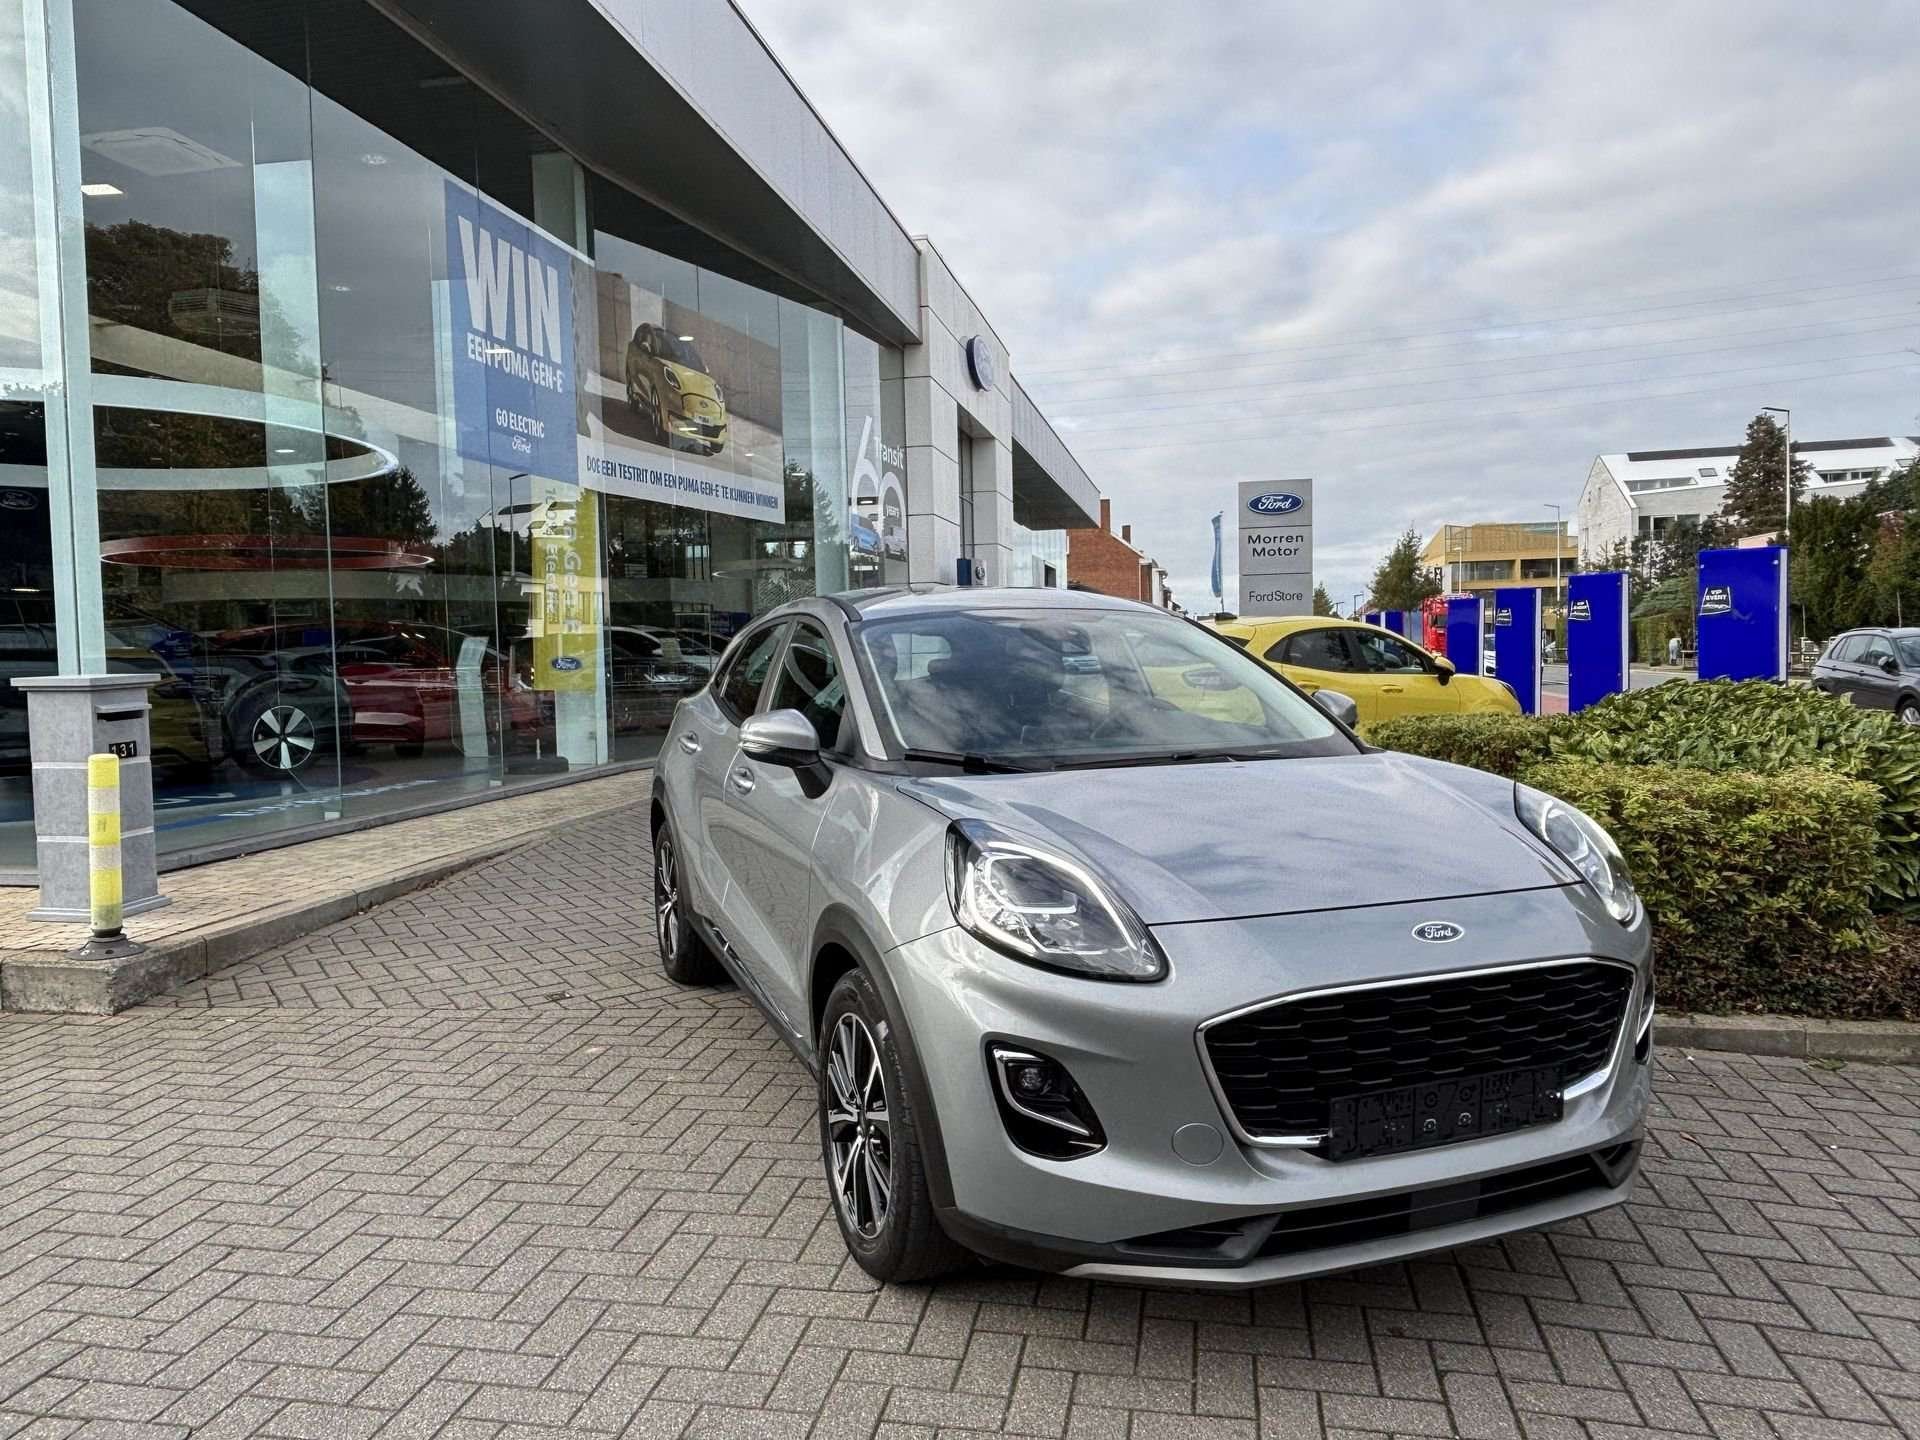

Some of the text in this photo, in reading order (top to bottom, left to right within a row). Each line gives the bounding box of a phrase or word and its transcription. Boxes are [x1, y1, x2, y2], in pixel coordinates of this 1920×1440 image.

[458, 215, 562, 364] WIN
[467, 332, 564, 393] EEN PUMA GEN-E
[495, 408, 545, 439] GO ELECTRIC
[512, 436, 532, 454] Ford
[873, 436, 905, 471] Transit
[586, 455, 601, 474] DOE
[601, 460, 617, 478] EEN
[618, 463, 649, 485] TESTRIT
[649, 470, 663, 487] OM
[664, 473, 677, 489] EEN
[678, 475, 700, 494] PUMA
[700, 480, 720, 498] GEN-E
[721, 485, 729, 500] TE
[1258, 495, 1293, 510] Ford
[1247, 534, 1304, 545] Morren
[1252, 546, 1300, 557] Motor
[1248, 590, 1303, 602] FordStore
[111, 743, 135, 757] 131
[1425, 925, 1454, 939] Ford
